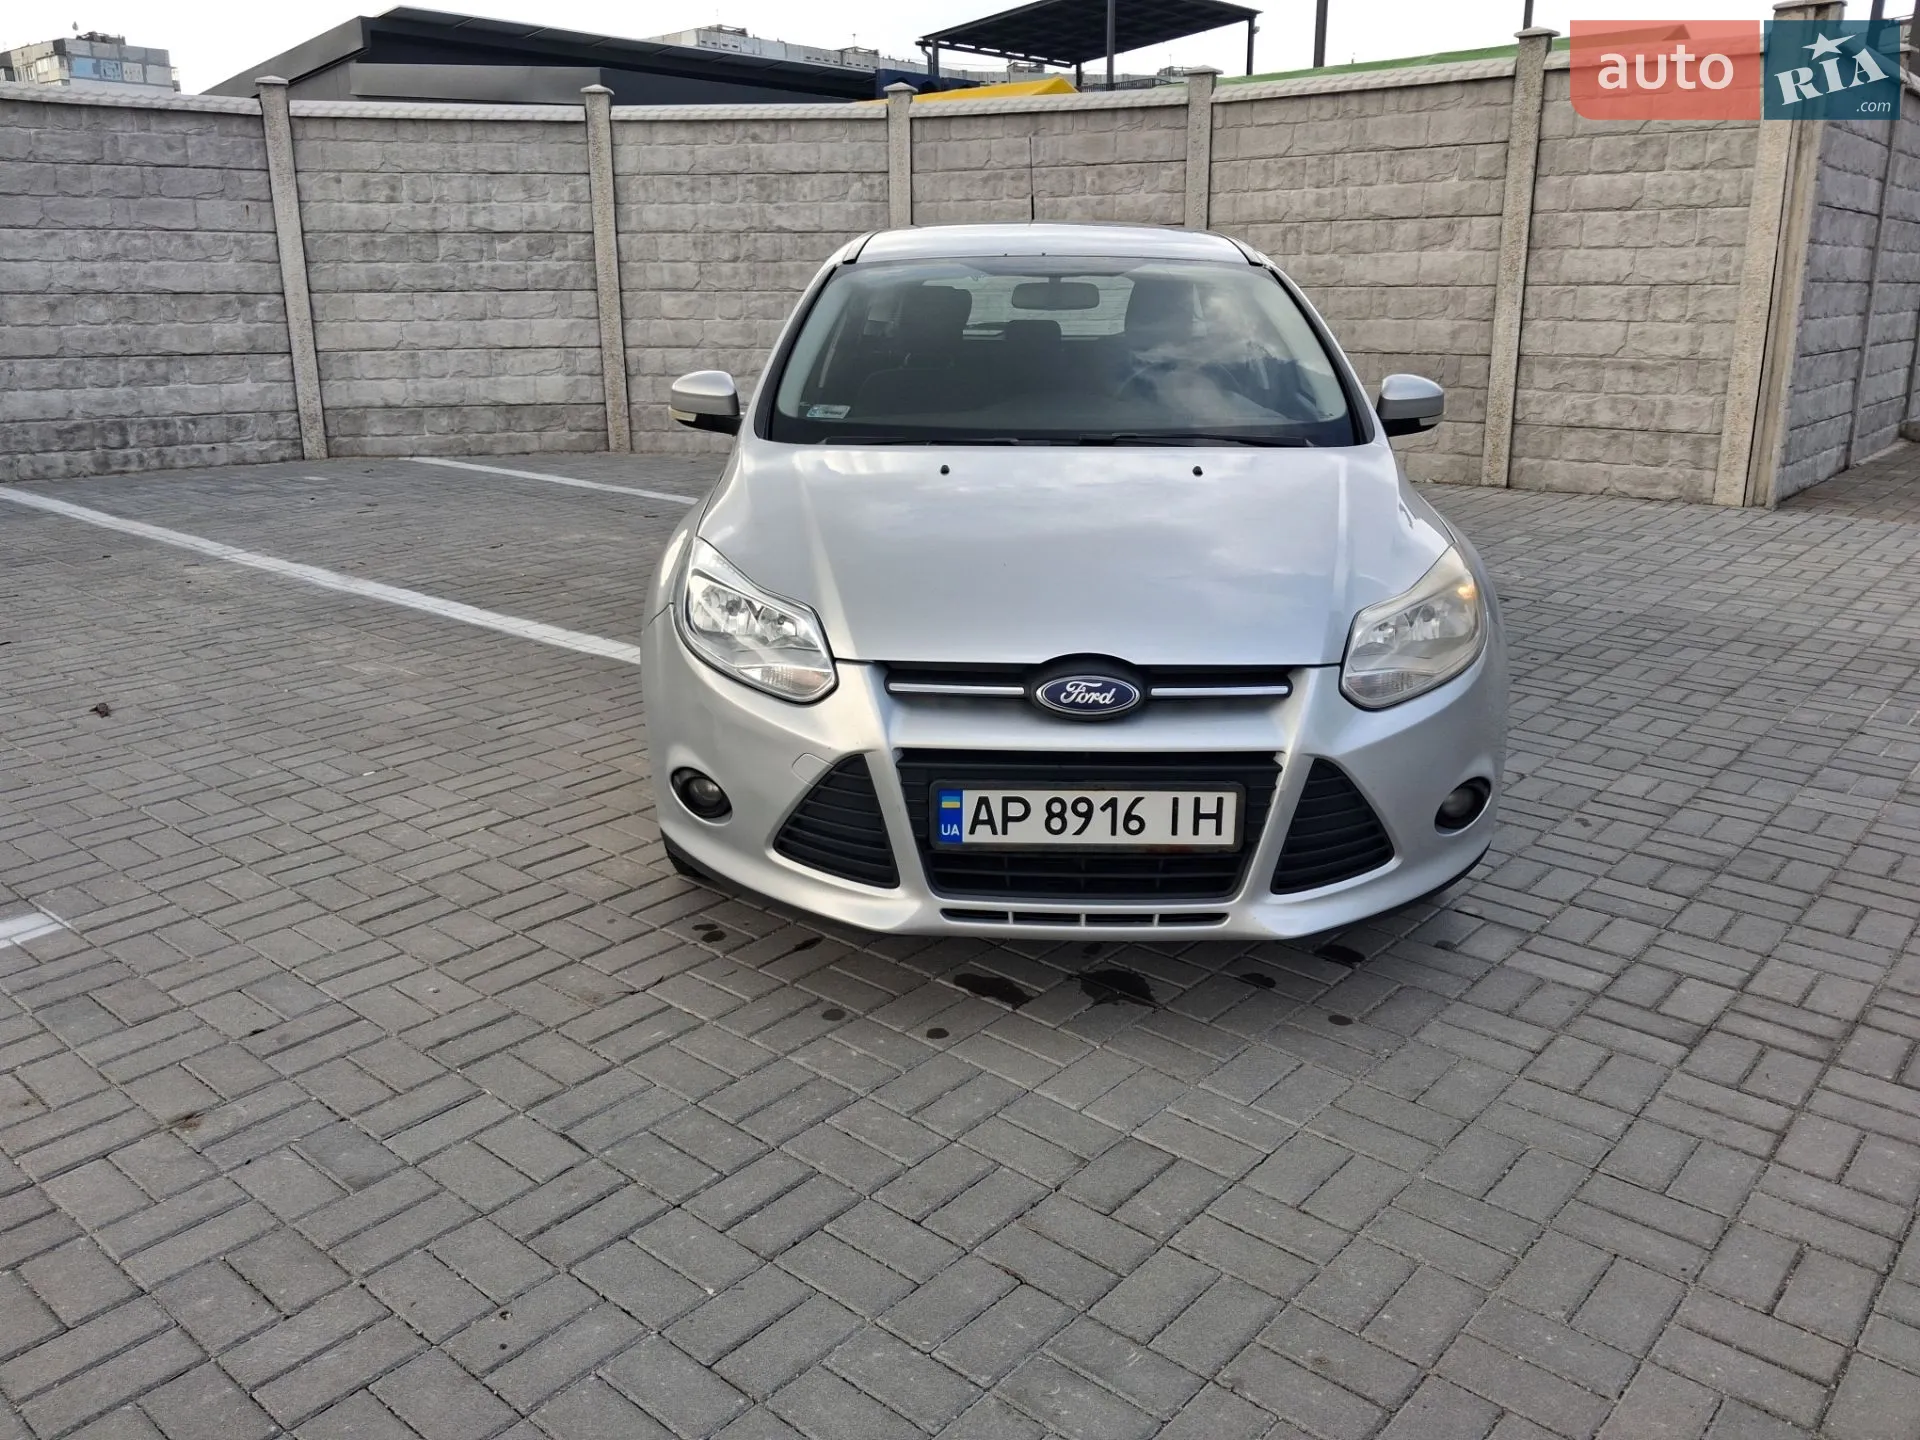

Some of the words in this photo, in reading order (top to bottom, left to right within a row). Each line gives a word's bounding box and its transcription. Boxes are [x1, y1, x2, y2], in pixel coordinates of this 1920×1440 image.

[1060, 681, 1117, 705] Ford
[968, 796, 1032, 836] AP
[1044, 796, 1146, 836] 8916
[1170, 796, 1224, 836] IH
[941, 824, 960, 836] UA
